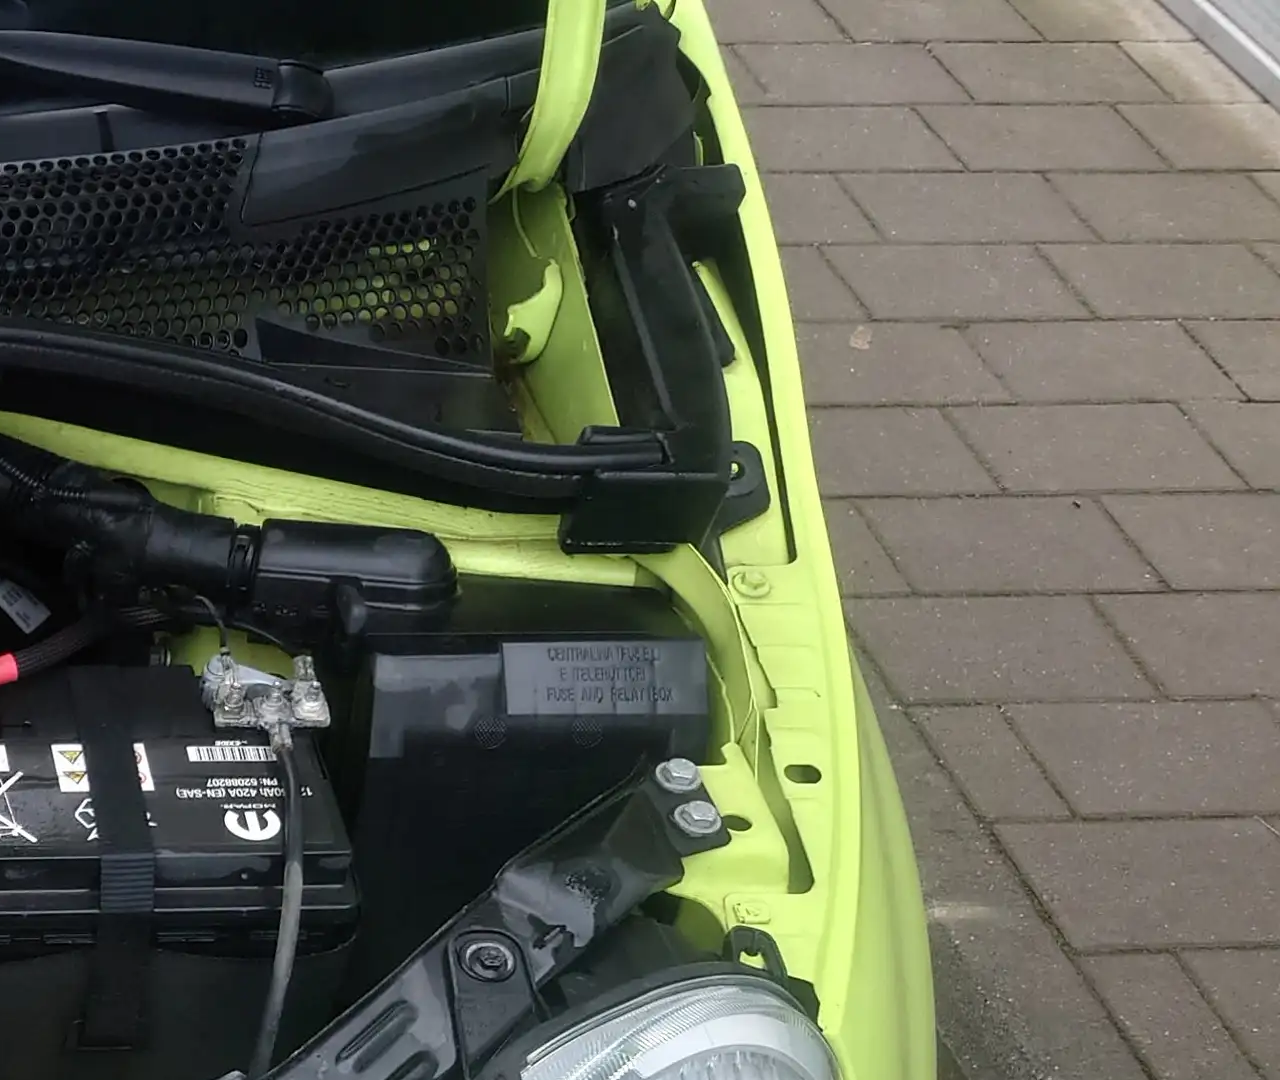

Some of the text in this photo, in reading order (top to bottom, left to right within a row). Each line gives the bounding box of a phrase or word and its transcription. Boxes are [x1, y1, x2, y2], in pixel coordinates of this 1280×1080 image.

[559, 667, 568, 681] E
[546, 687, 674, 703] FUSE AND RELAY BOX
[260, 777, 278, 786] PN:
[175, 787, 226, 799] (EN-SAE)
[228, 788, 257, 798] 420A
